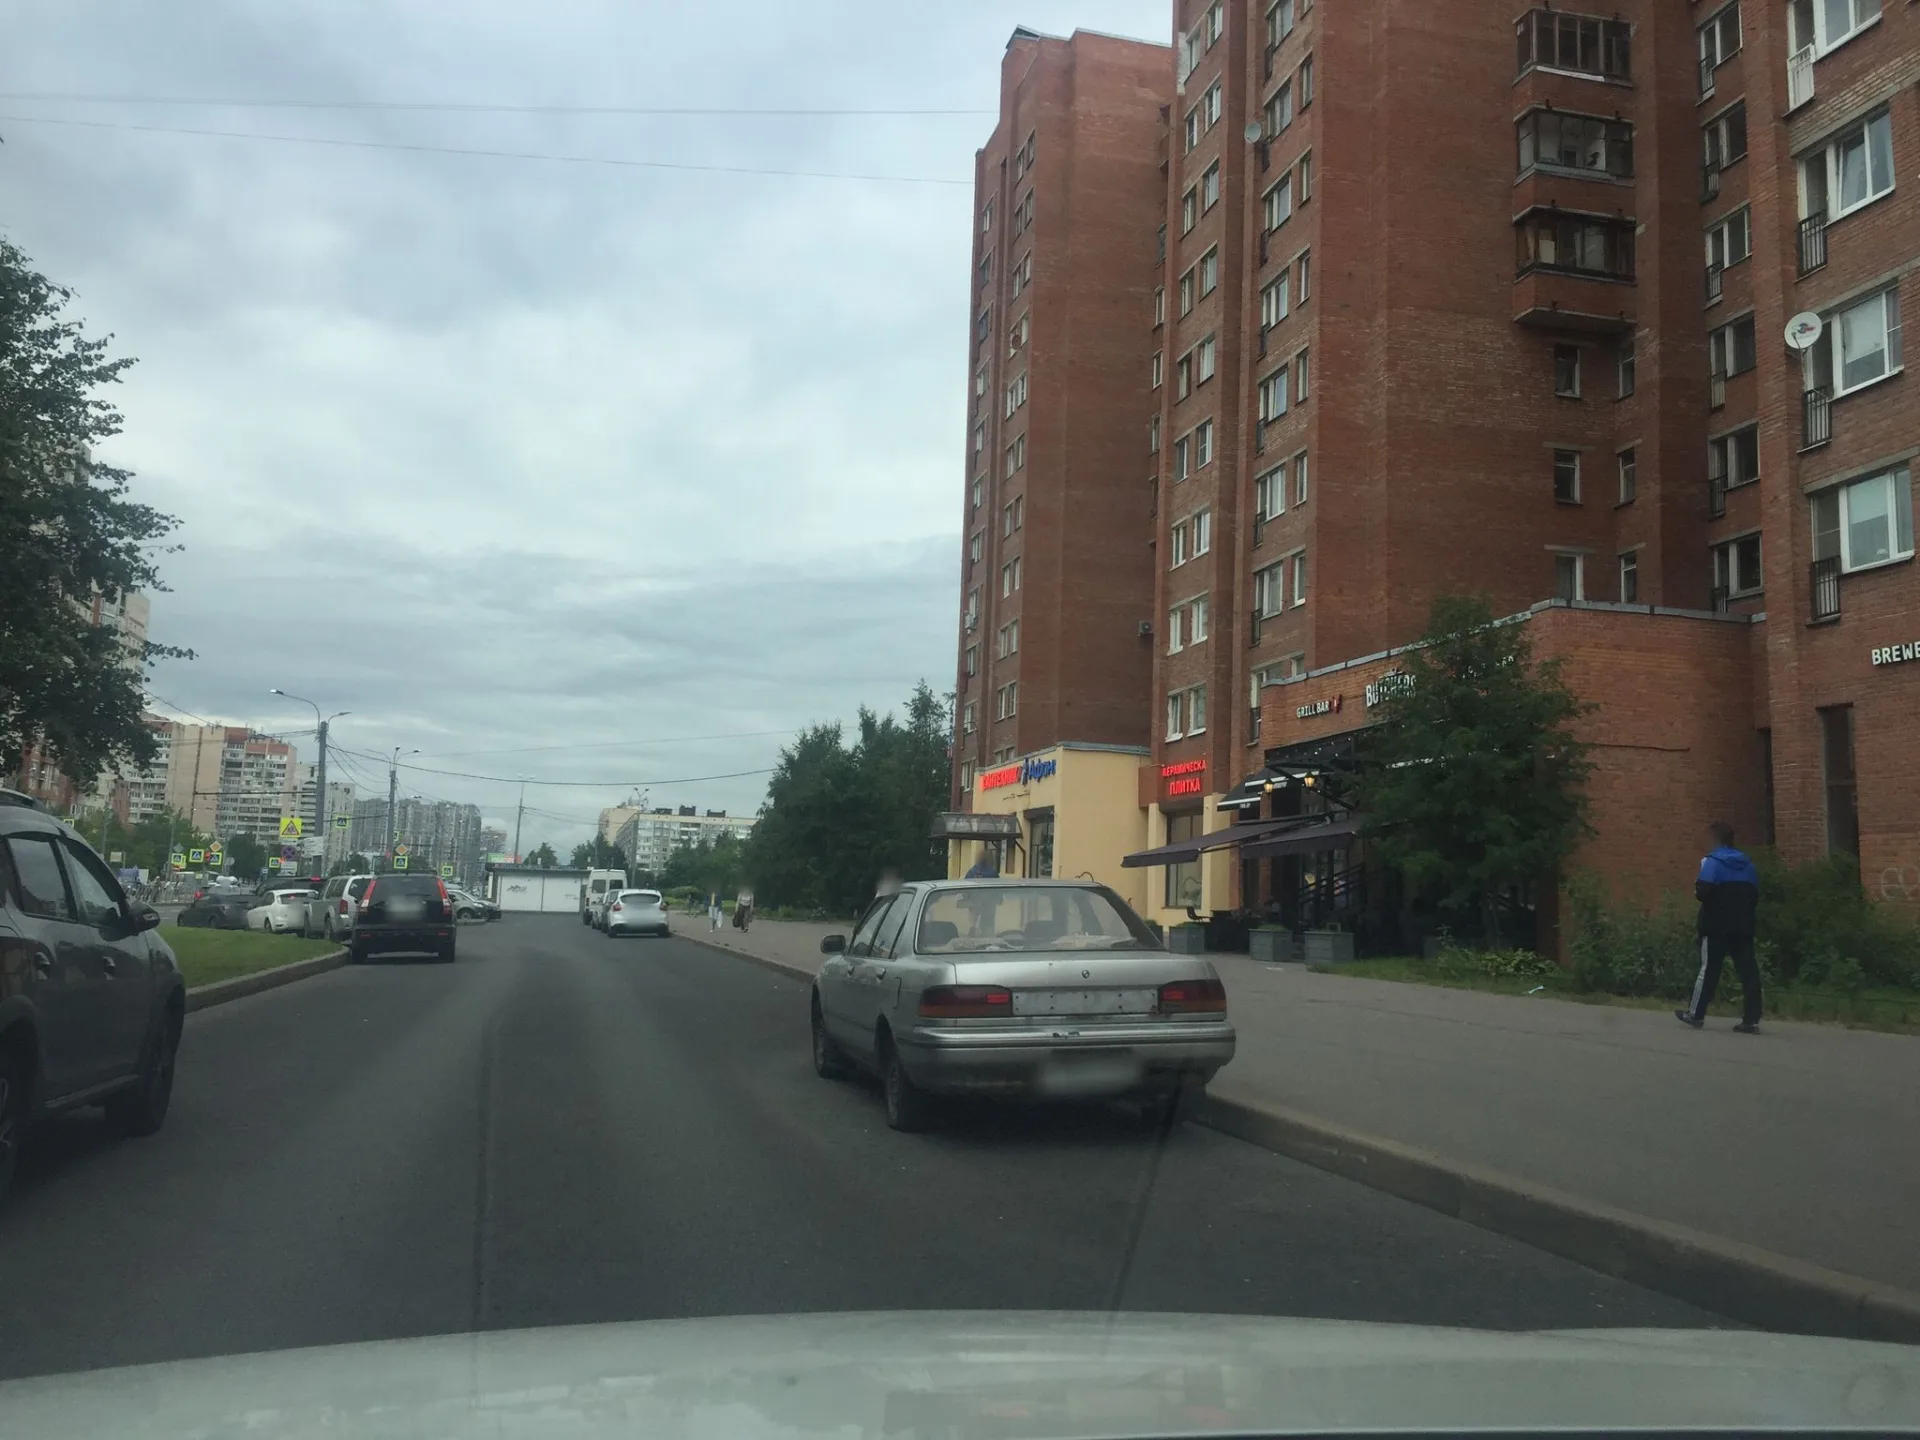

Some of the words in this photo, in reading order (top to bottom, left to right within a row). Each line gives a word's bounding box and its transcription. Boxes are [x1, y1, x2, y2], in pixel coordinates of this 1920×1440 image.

[1296, 703, 1316, 718] GRILL
[1316, 700, 1330, 714] BAR
[1169, 777, 1201, 796] ПЛИТКА
